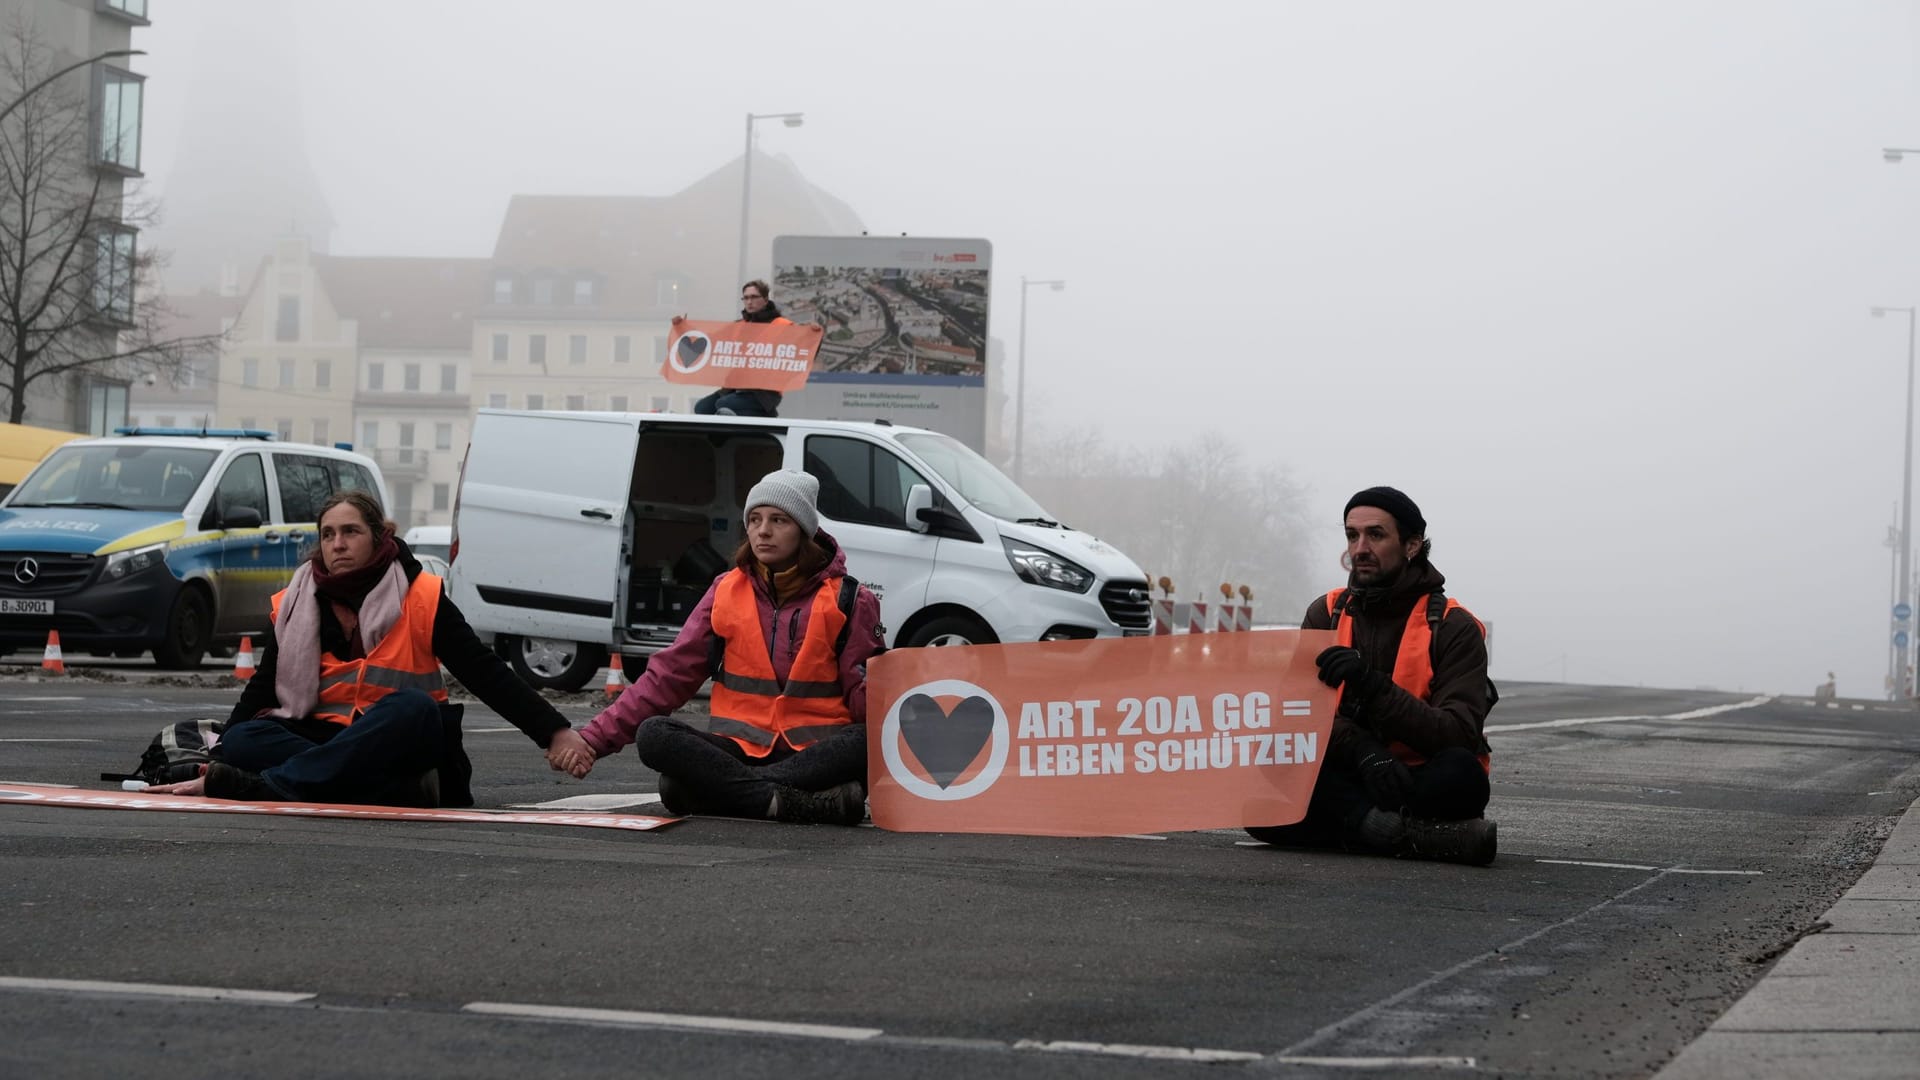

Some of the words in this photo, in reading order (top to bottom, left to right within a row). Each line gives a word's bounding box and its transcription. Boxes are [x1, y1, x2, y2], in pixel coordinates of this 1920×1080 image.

[713, 341, 742, 355] ART.
[745, 342, 773, 356] 20A
[776, 344, 797, 359] GG
[711, 355, 746, 368] LEBEN
[749, 355, 808, 371] SCHÜTZEN
[4, 520, 99, 532] POLIZEI
[1017, 700, 1106, 739] ART.
[1117, 695, 1202, 736] 20A
[1212, 691, 1271, 731] GG
[1019, 742, 1124, 777] LEBEN
[1134, 732, 1317, 773] SCHÜTZEN
